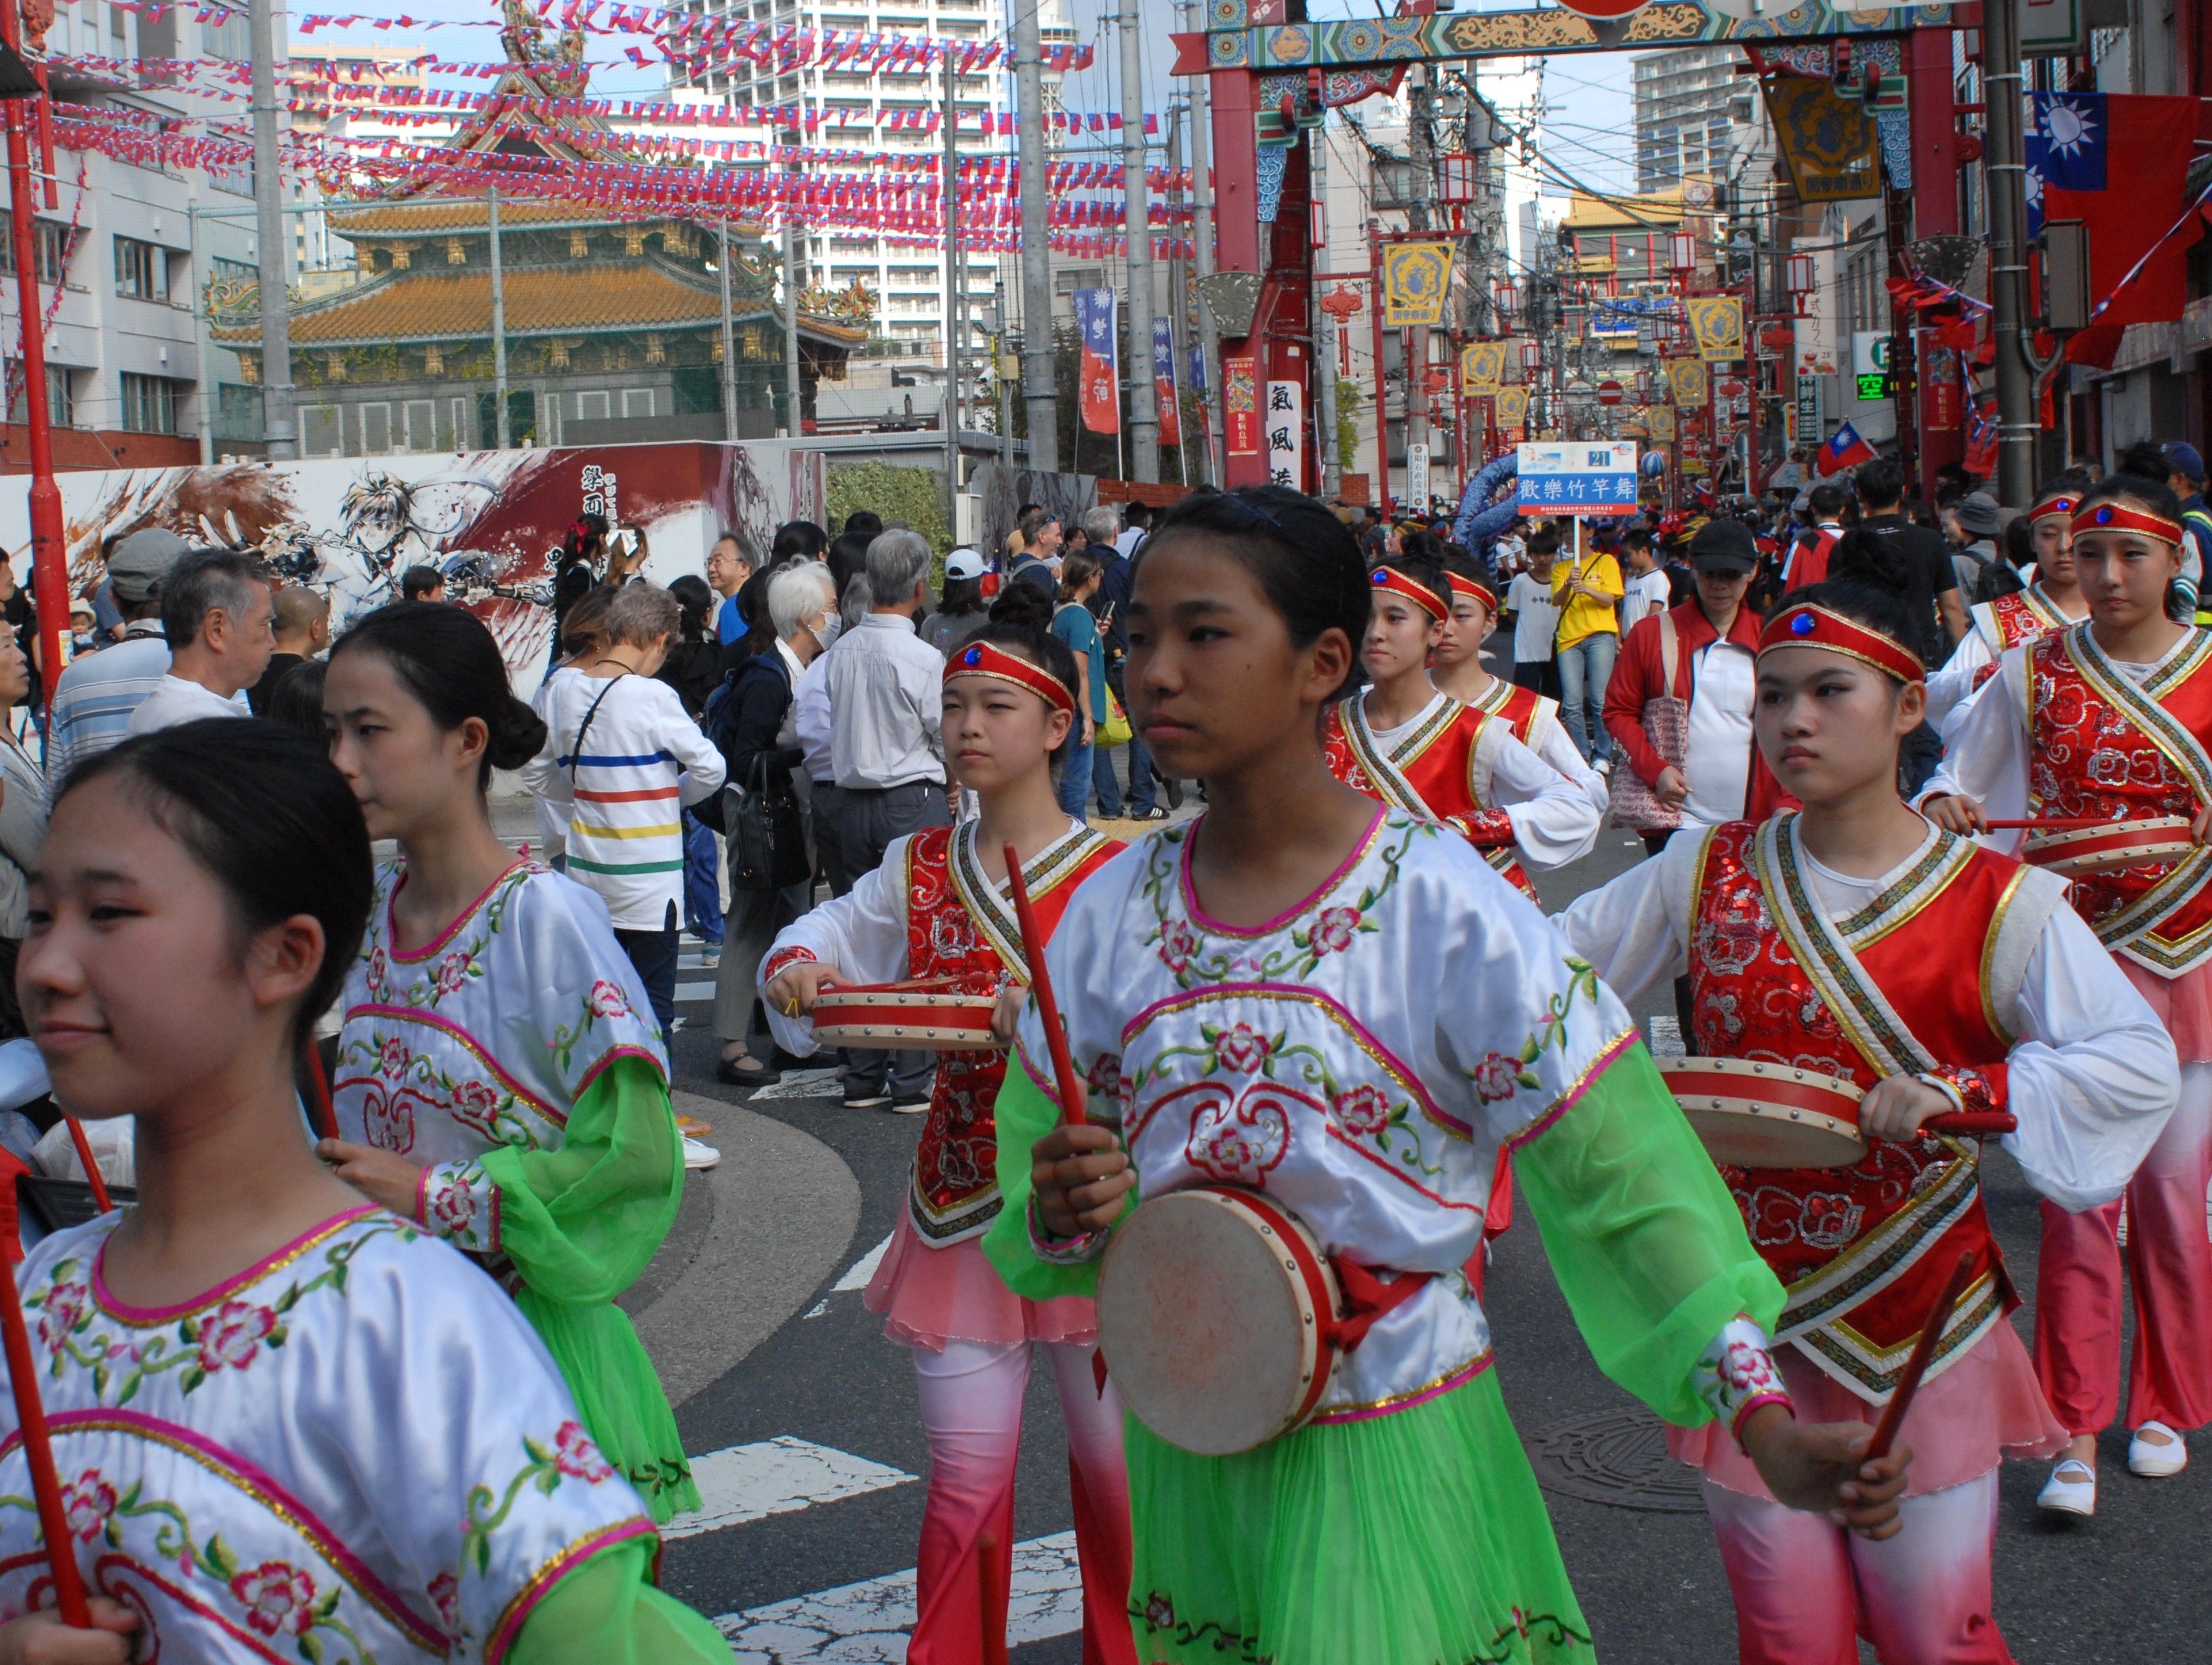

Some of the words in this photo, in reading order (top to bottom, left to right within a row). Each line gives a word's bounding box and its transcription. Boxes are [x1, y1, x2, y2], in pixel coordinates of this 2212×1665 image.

[1858, 374, 1883, 399] 空
[1592, 452, 1607, 467] 21
[1519, 477, 1636, 500] 歡樂竹竿舞
